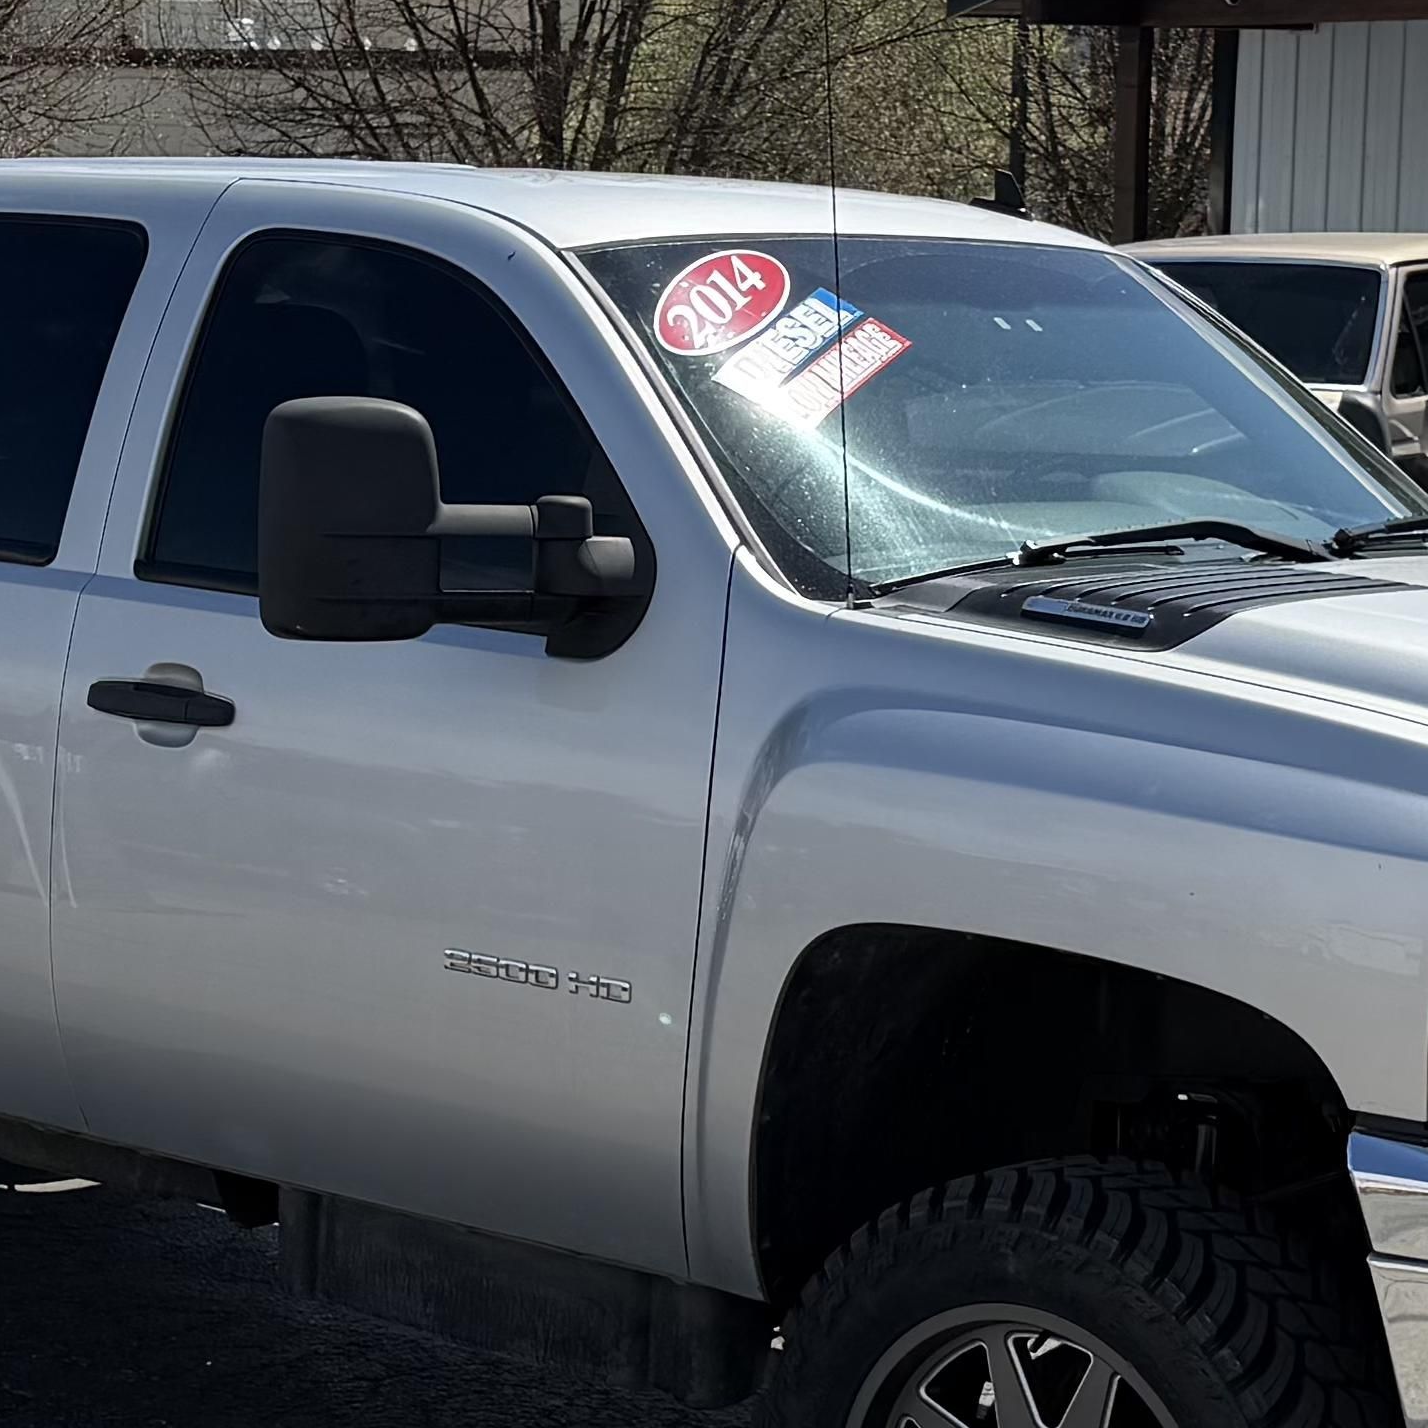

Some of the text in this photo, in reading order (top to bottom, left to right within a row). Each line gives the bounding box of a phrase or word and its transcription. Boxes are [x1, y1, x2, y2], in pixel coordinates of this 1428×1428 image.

[667, 255, 766, 349] 2014
[443, 948, 632, 1003] 2500 HD
